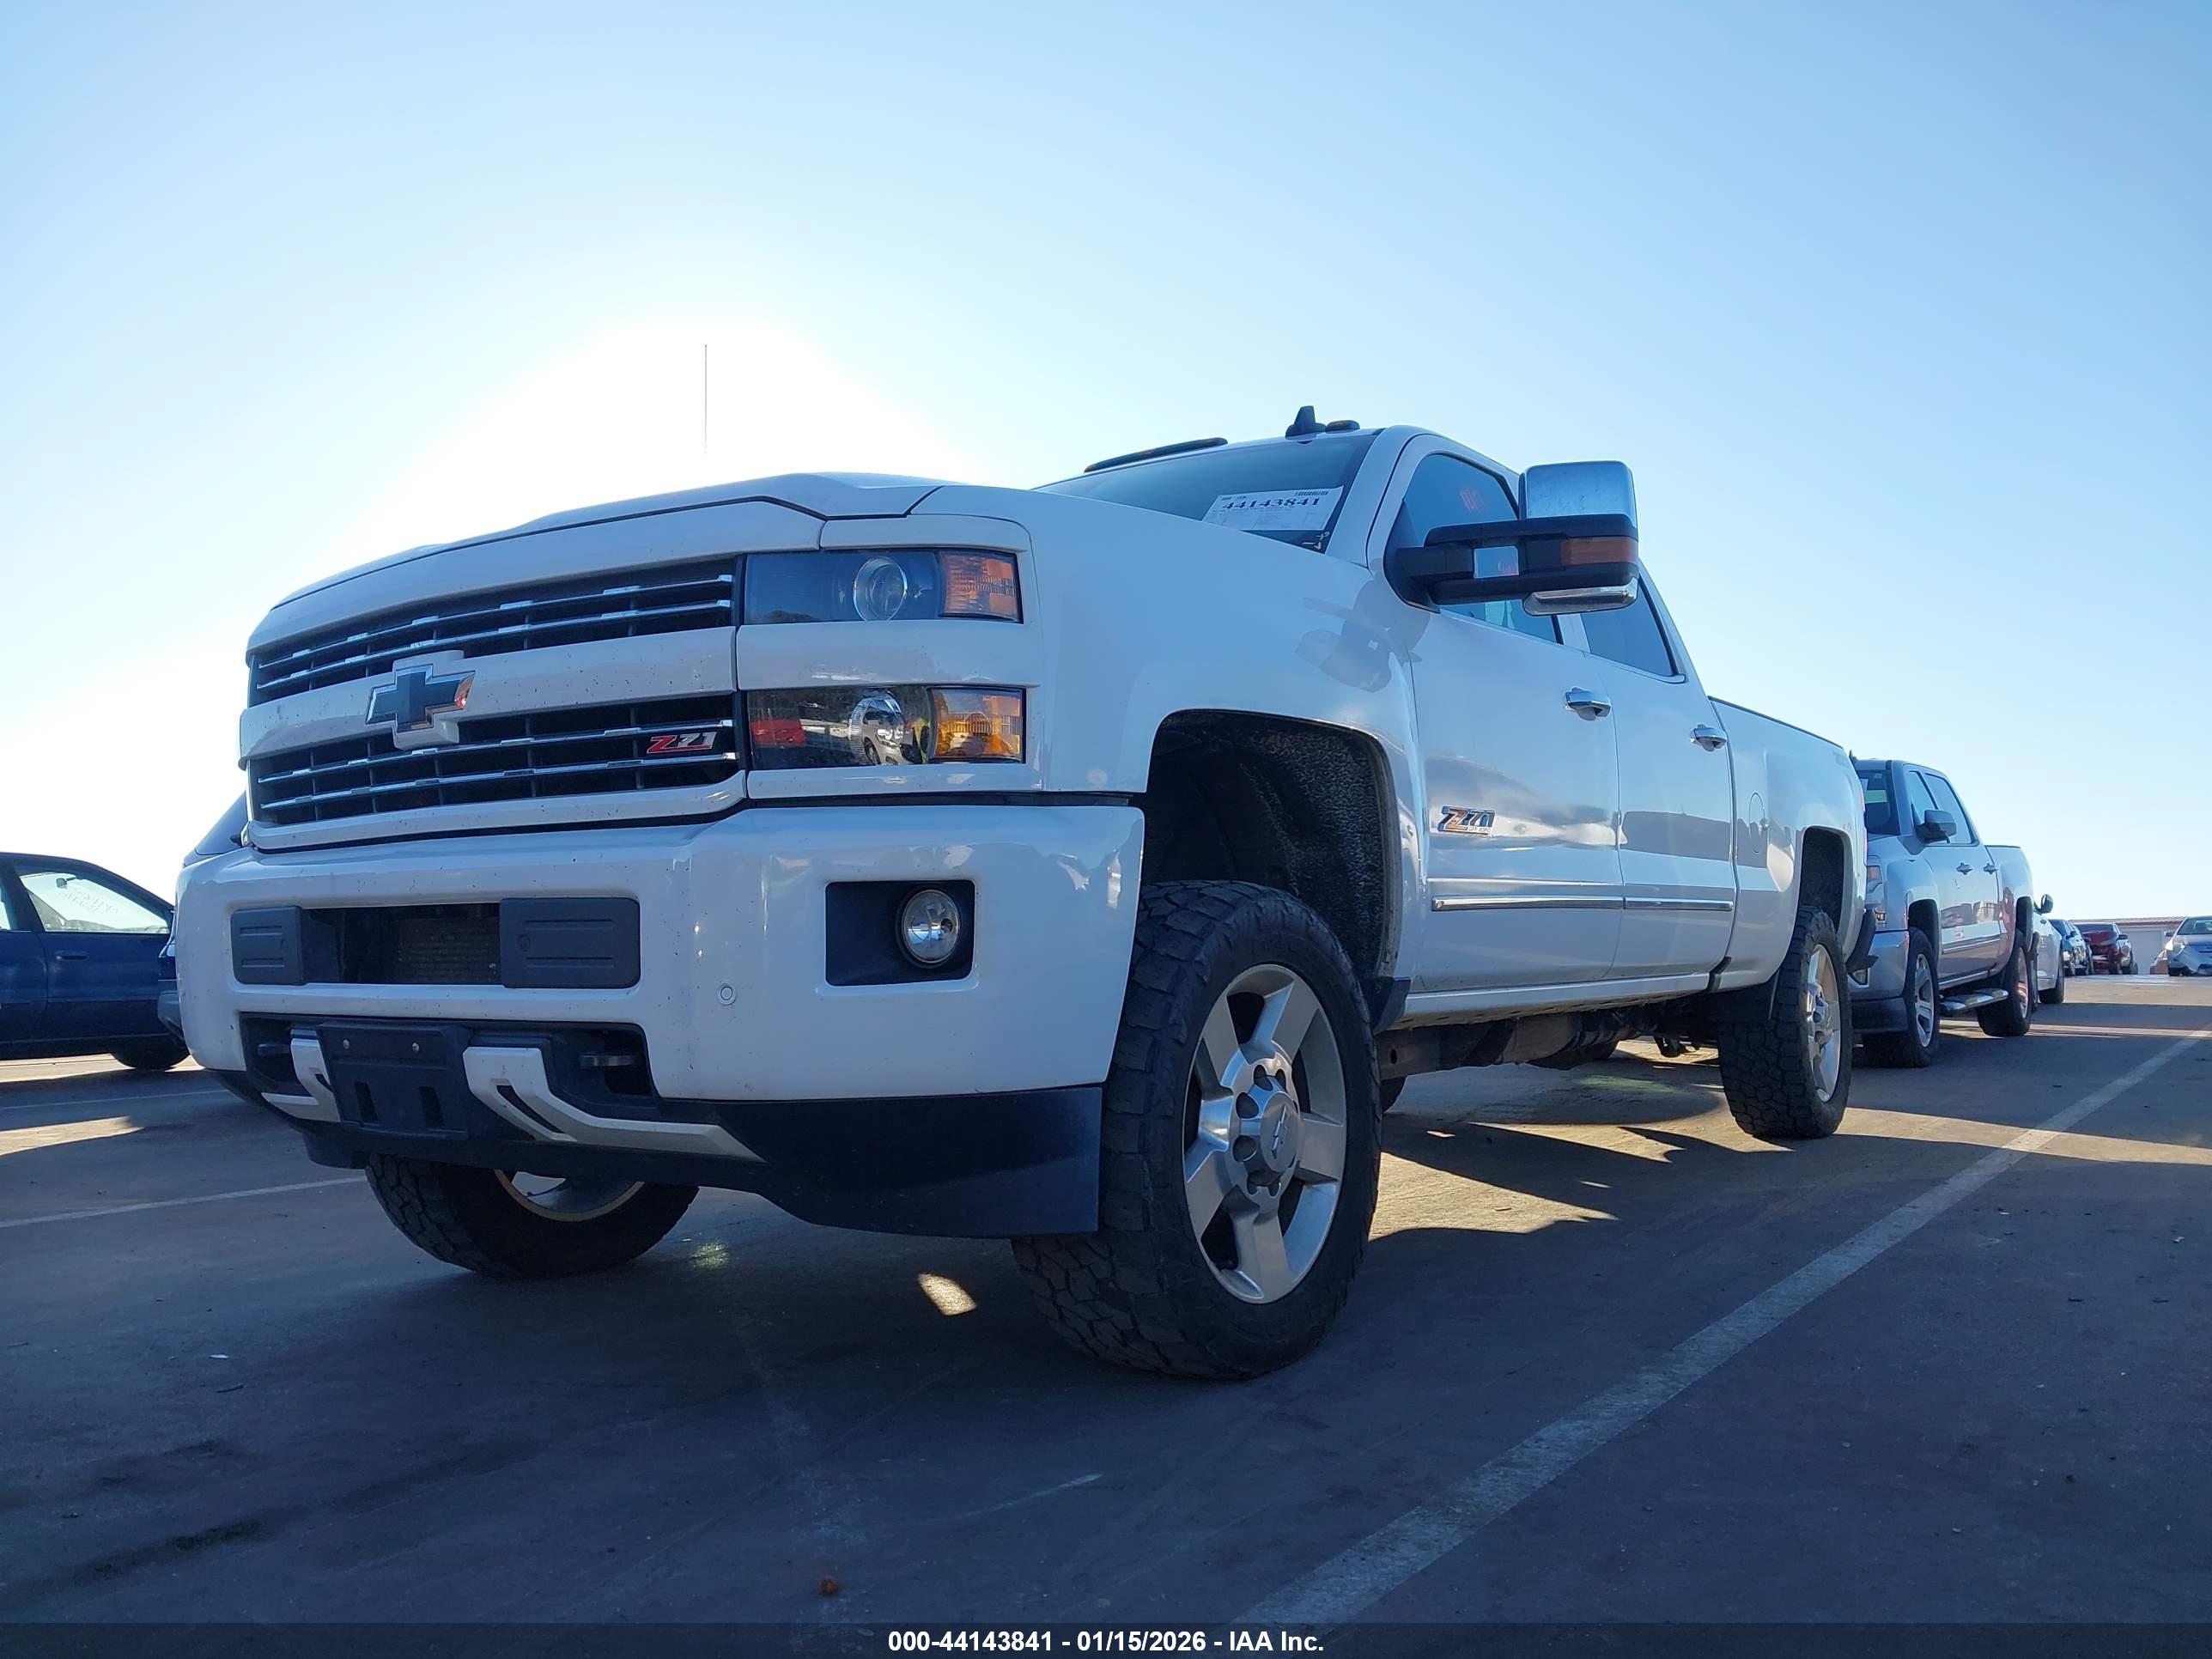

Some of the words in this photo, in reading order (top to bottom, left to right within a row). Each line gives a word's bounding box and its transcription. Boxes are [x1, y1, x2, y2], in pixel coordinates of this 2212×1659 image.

[1223, 498, 1320, 509] 44143841
[647, 732, 717, 754] Z71
[1437, 805, 1495, 834] Z71
